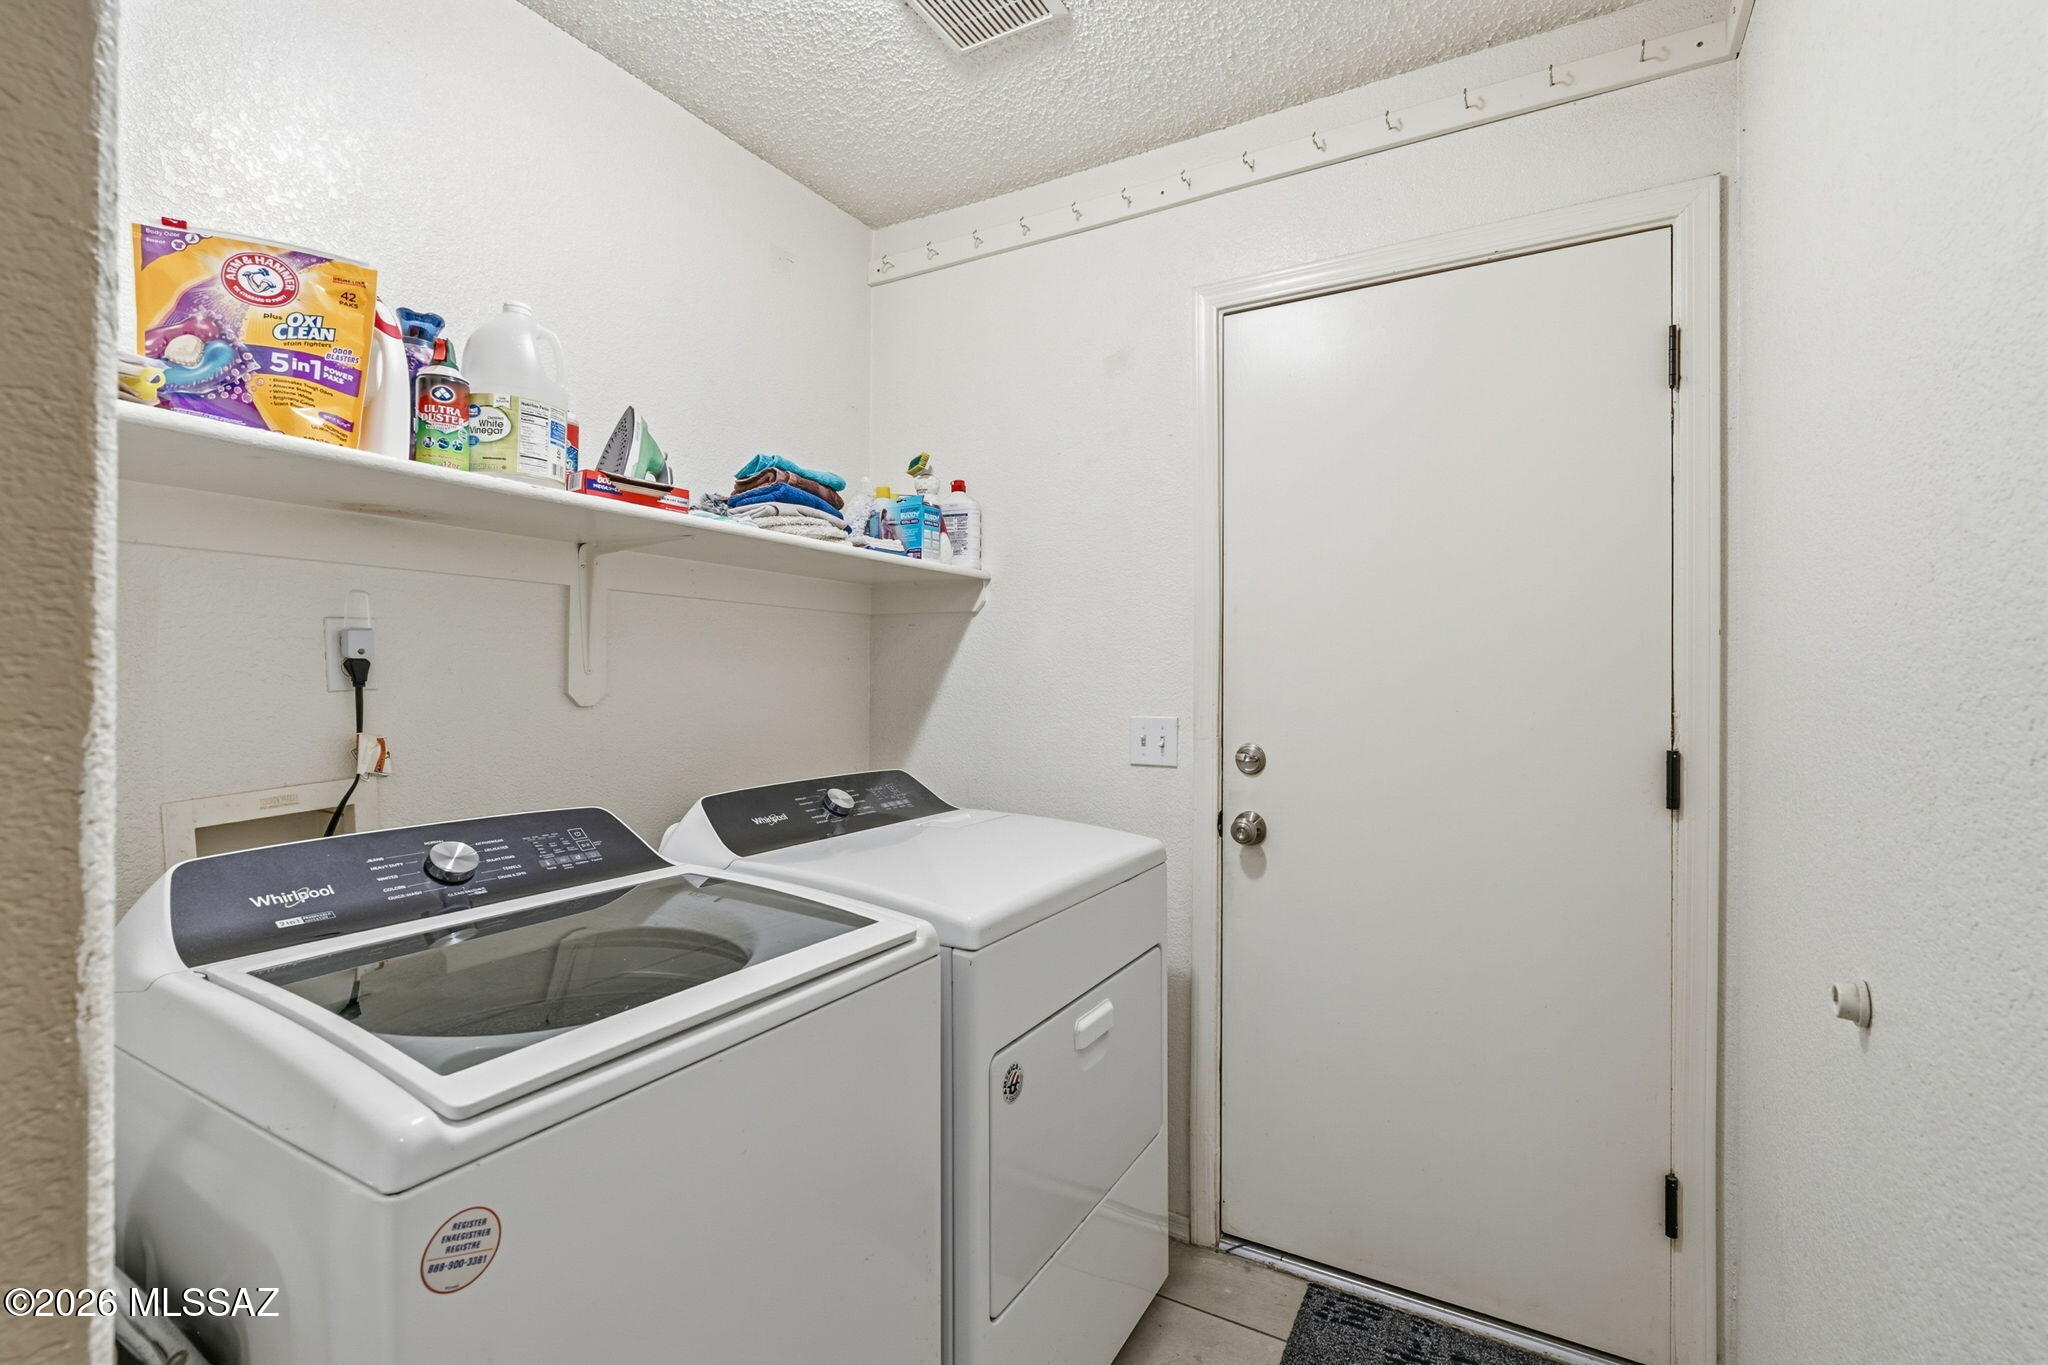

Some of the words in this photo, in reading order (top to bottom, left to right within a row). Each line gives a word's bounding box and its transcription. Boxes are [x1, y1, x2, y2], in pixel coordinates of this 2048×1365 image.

[226, 258, 244, 280] ARM
[242, 256, 252, 264] &
[254, 256, 296, 291] HAMMER
[340, 292, 356, 303] 42
[339, 300, 358, 309] PAKS
[263, 312, 282, 320] plus
[286, 312, 324, 328] OXI
[272, 323, 336, 342] CLEAN
[326, 353, 360, 364] BLASTERS
[323, 365, 354, 382] POWER
[424, 404, 462, 417] ULTRA
[479, 420, 504, 428] White
[470, 426, 504, 436] Vinegar
[751, 812, 788, 825] Whirlpool
[248, 884, 335, 908] Whirlpool
[452, 1218, 488, 1230] REGISTER
[441, 1228, 491, 1244] ENREGISTRER
[445, 1240, 481, 1254] REGISTRE
